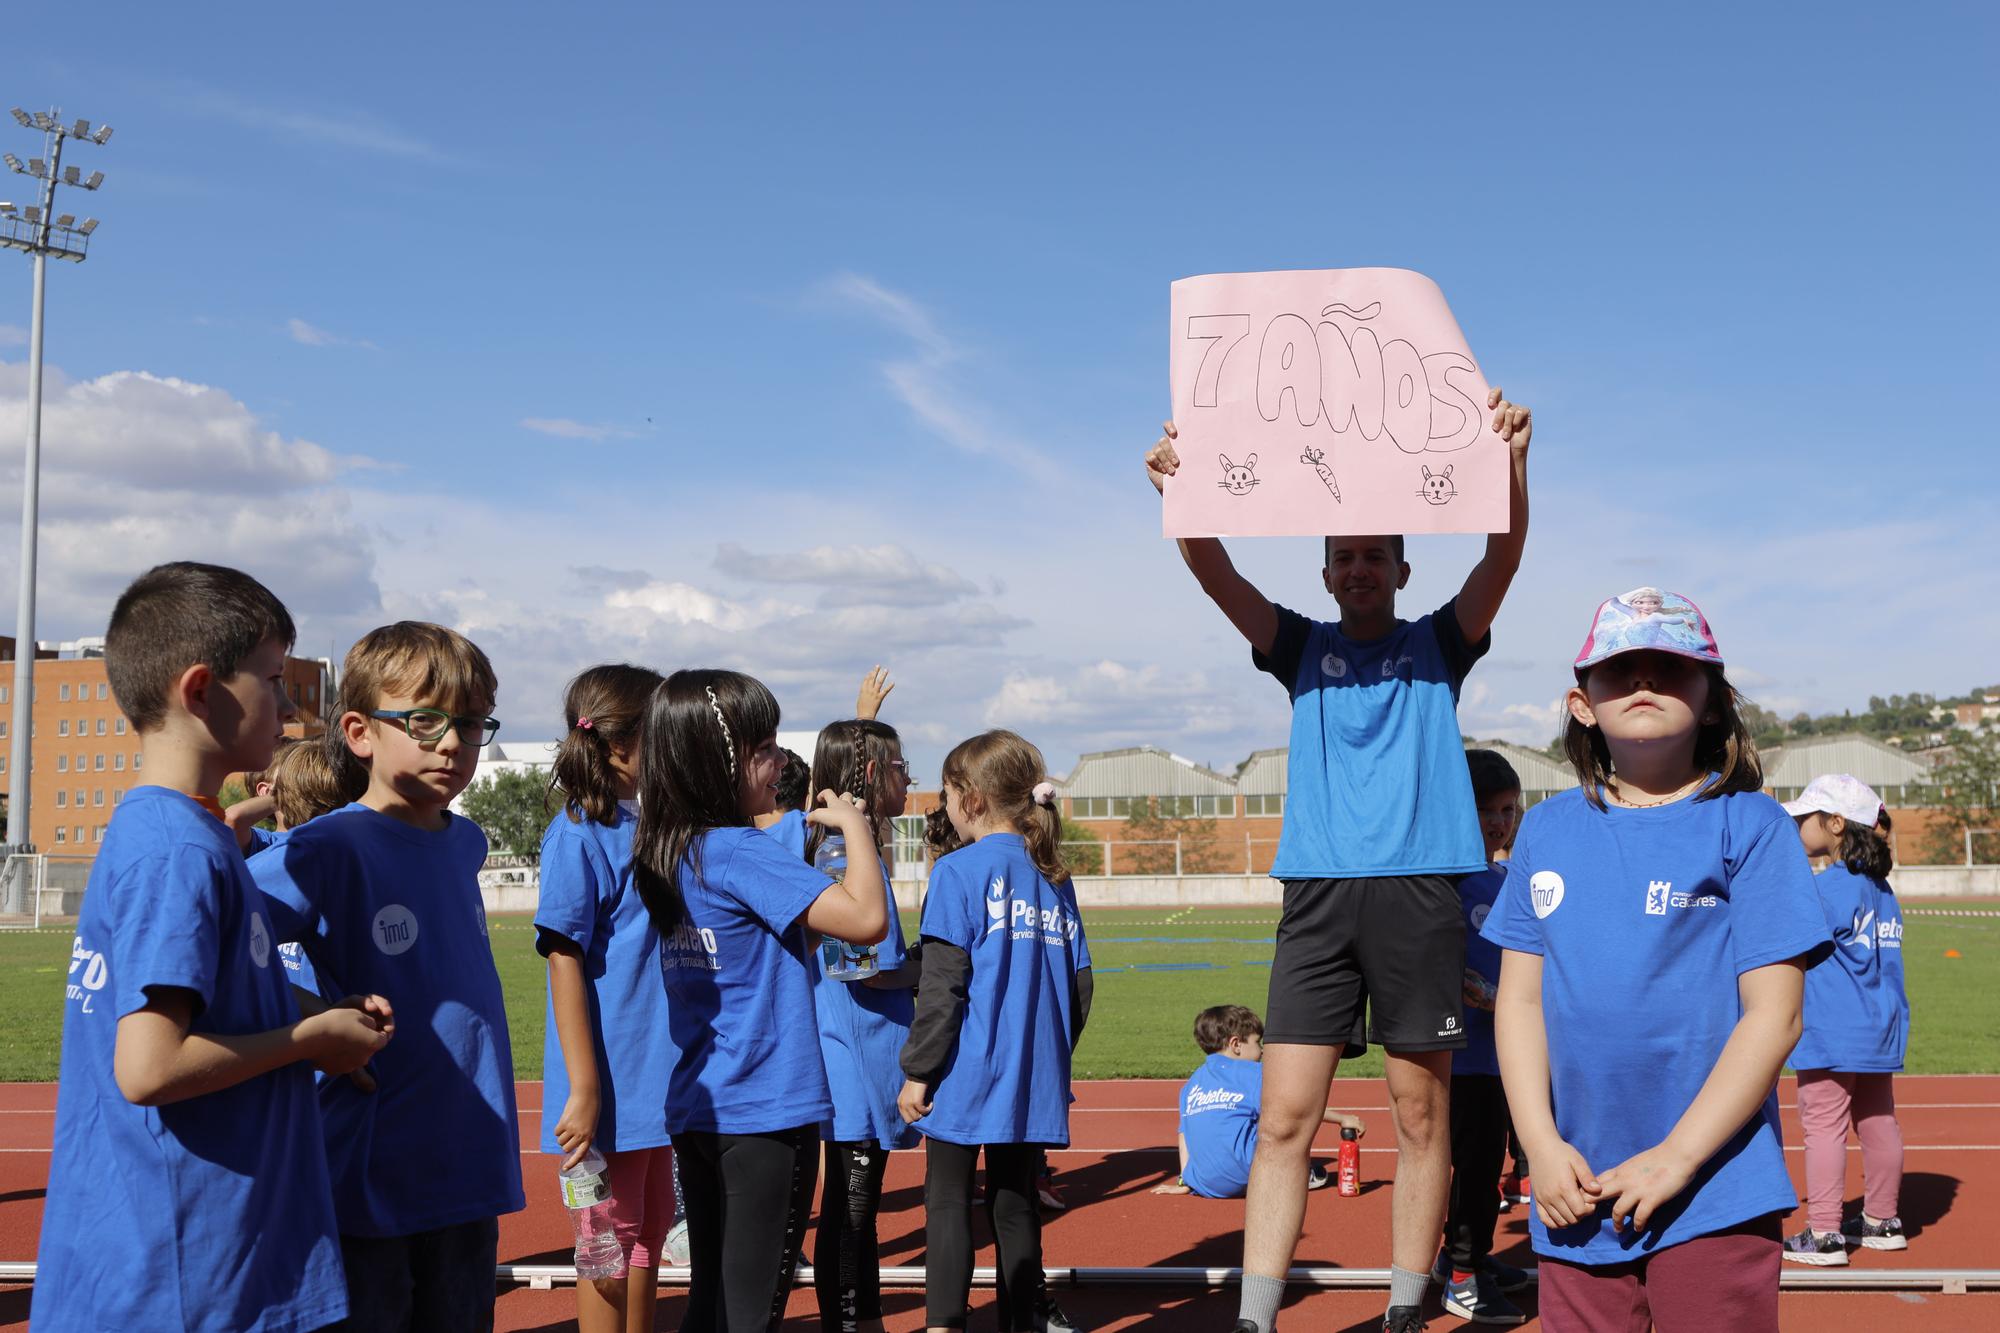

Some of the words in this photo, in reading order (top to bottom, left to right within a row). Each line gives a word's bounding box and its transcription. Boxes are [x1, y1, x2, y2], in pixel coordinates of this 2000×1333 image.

[1187, 313, 1250, 407] 7
[1256, 301, 1482, 454] AÑOS
[1533, 883, 1555, 908] imd
[379, 920, 409, 945] imd
